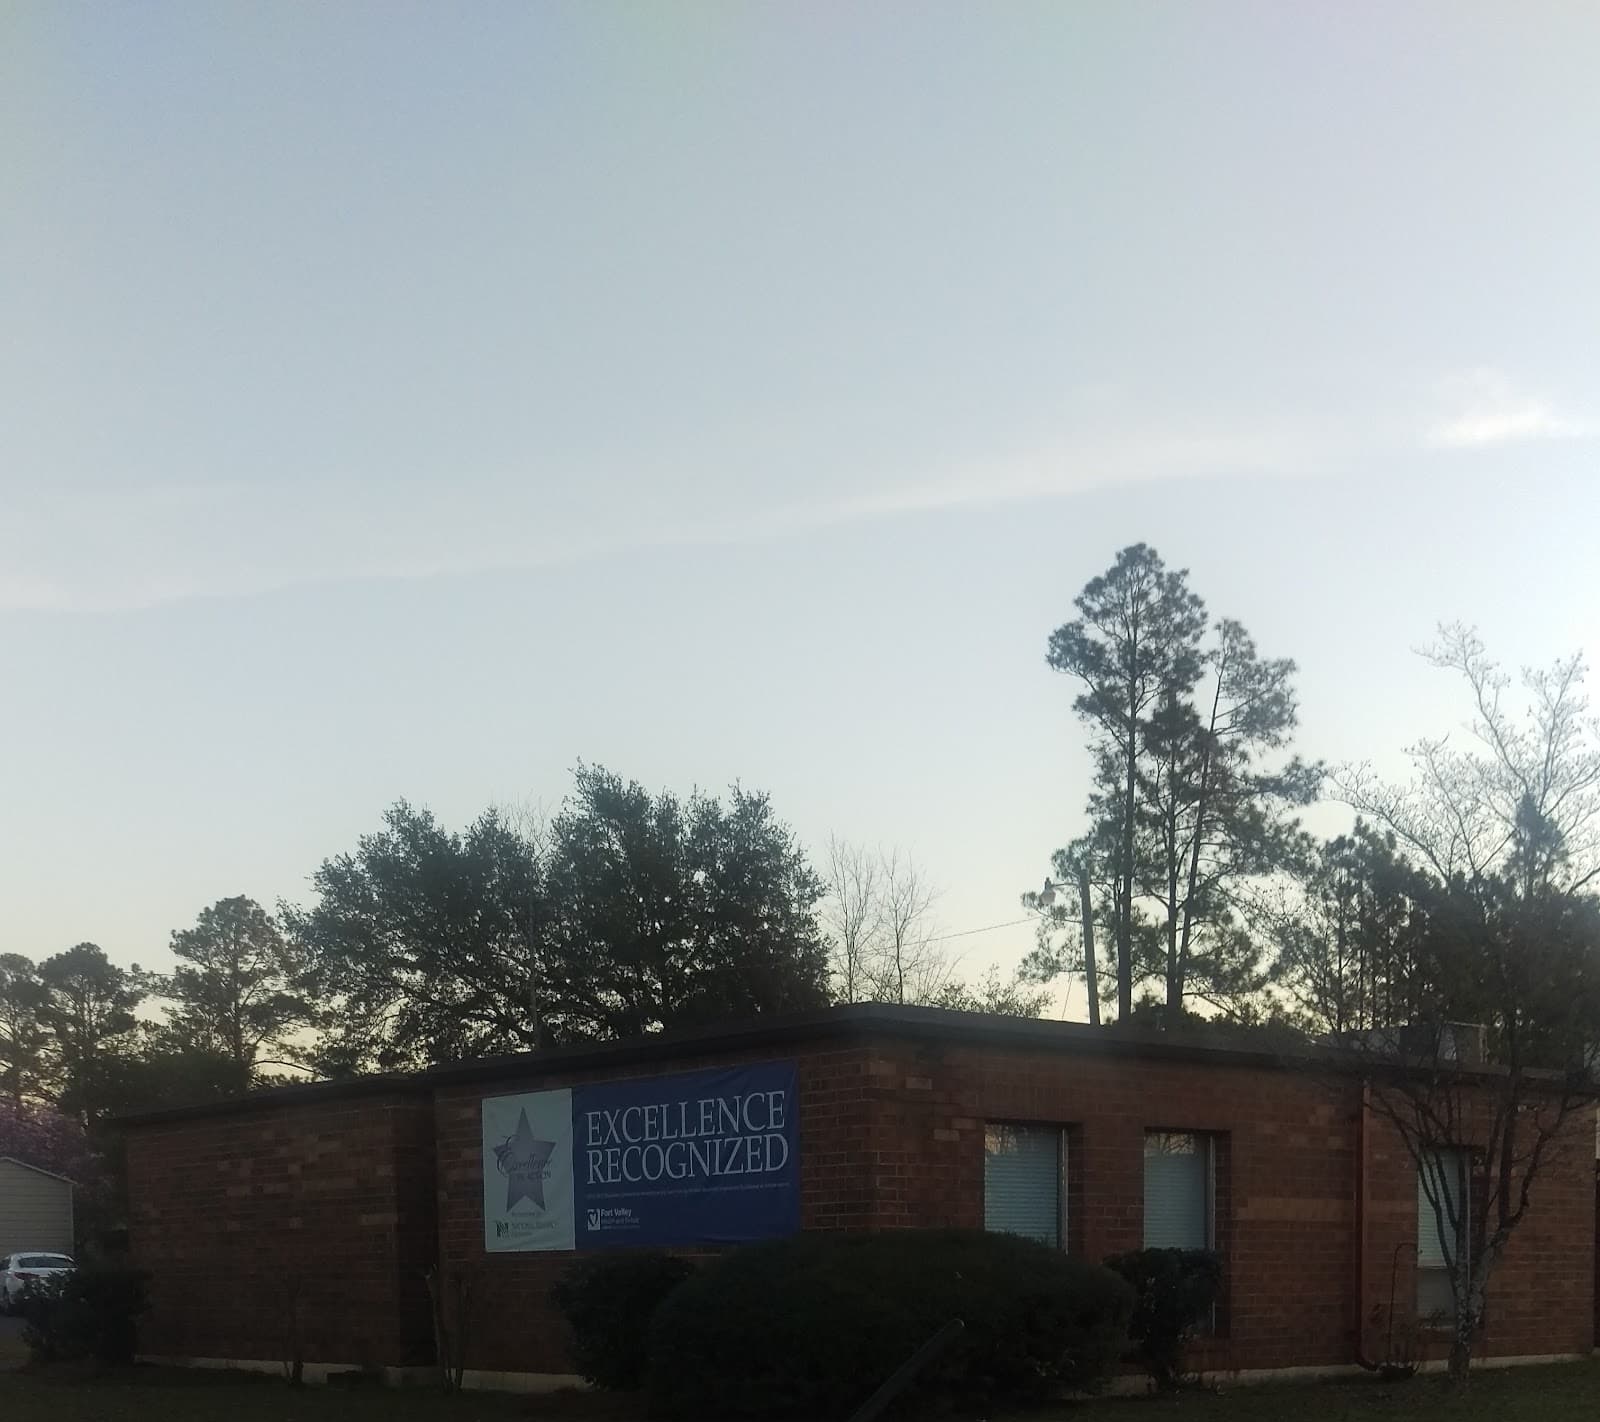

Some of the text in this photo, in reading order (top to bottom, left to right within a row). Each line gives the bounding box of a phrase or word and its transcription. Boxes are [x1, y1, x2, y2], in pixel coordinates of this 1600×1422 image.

[585, 1091, 786, 1146] EXCELLENCE
[587, 1133, 789, 1184] RECOGNIZED
[600, 1207, 632, 1217] Fort Valley
